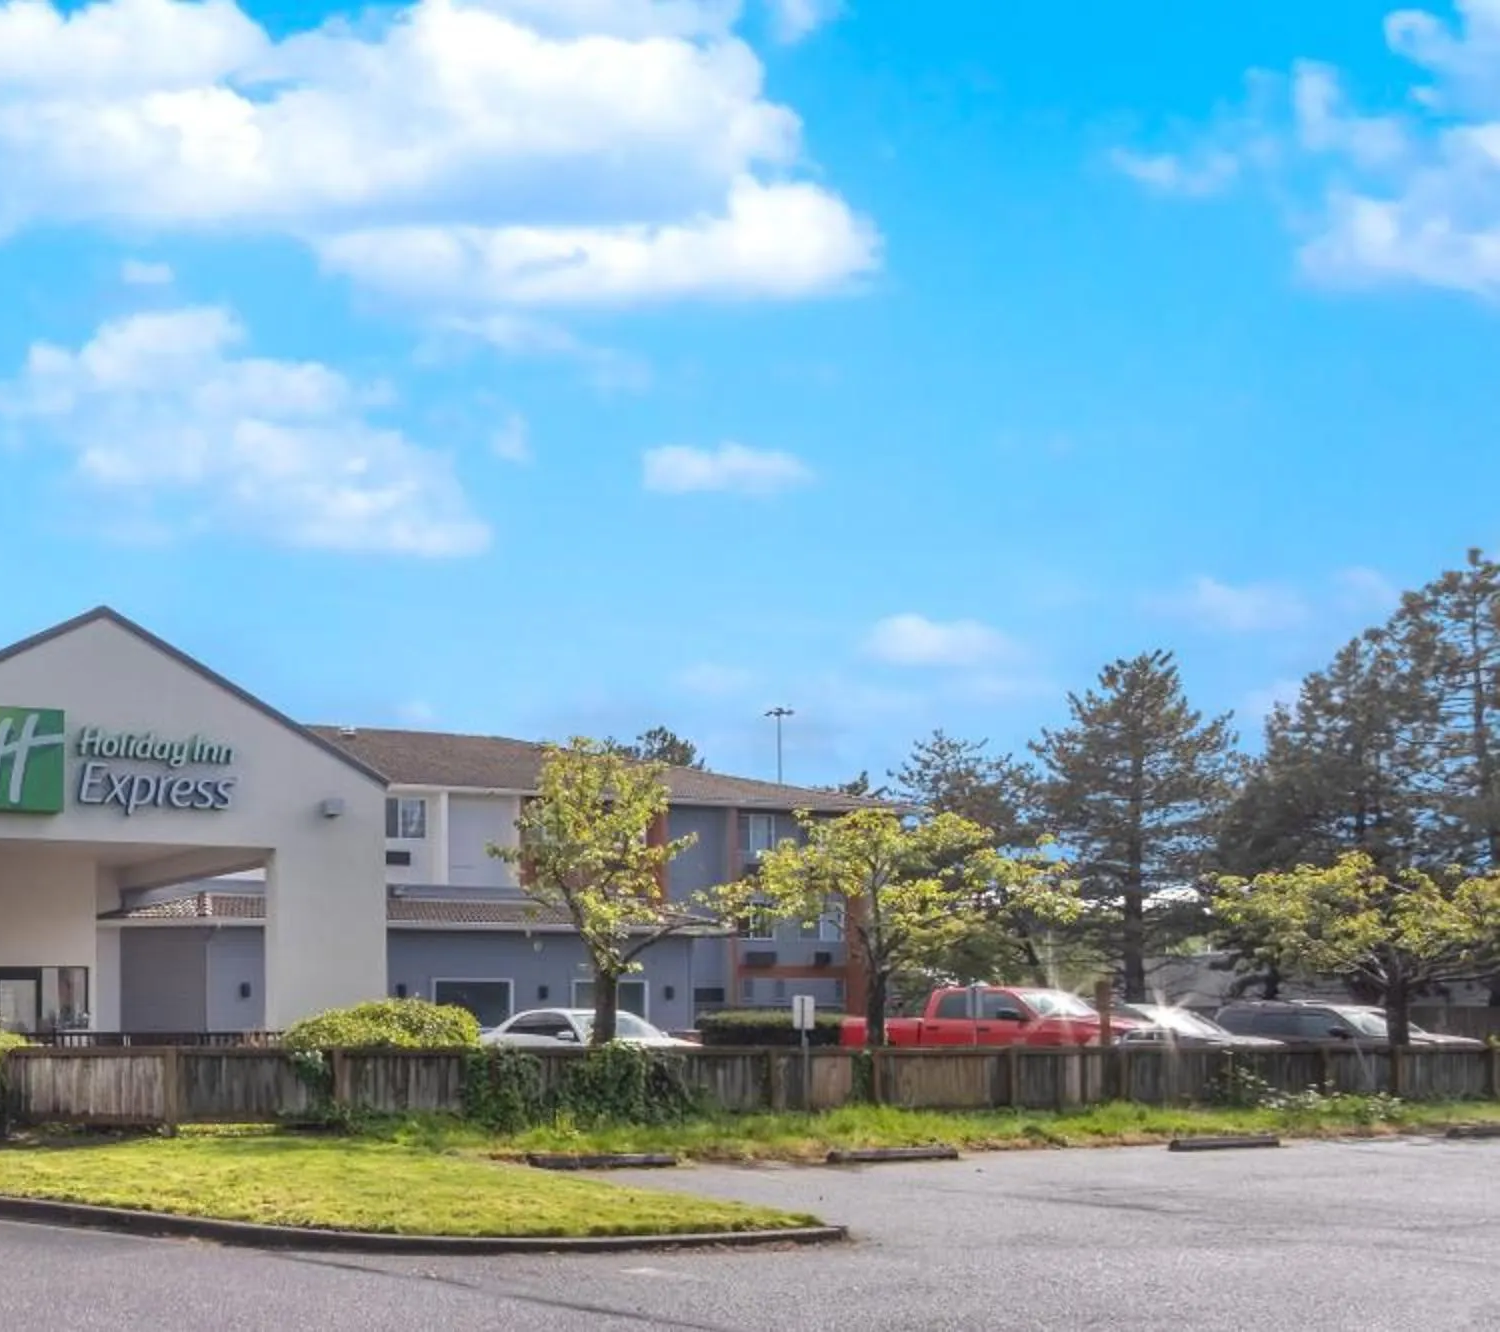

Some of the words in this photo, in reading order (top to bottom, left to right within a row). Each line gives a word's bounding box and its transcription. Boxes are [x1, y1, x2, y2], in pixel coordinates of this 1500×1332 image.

[79, 729, 188, 767] Holiday
[193, 736, 235, 763] Inn
[78, 762, 237, 814] Express
